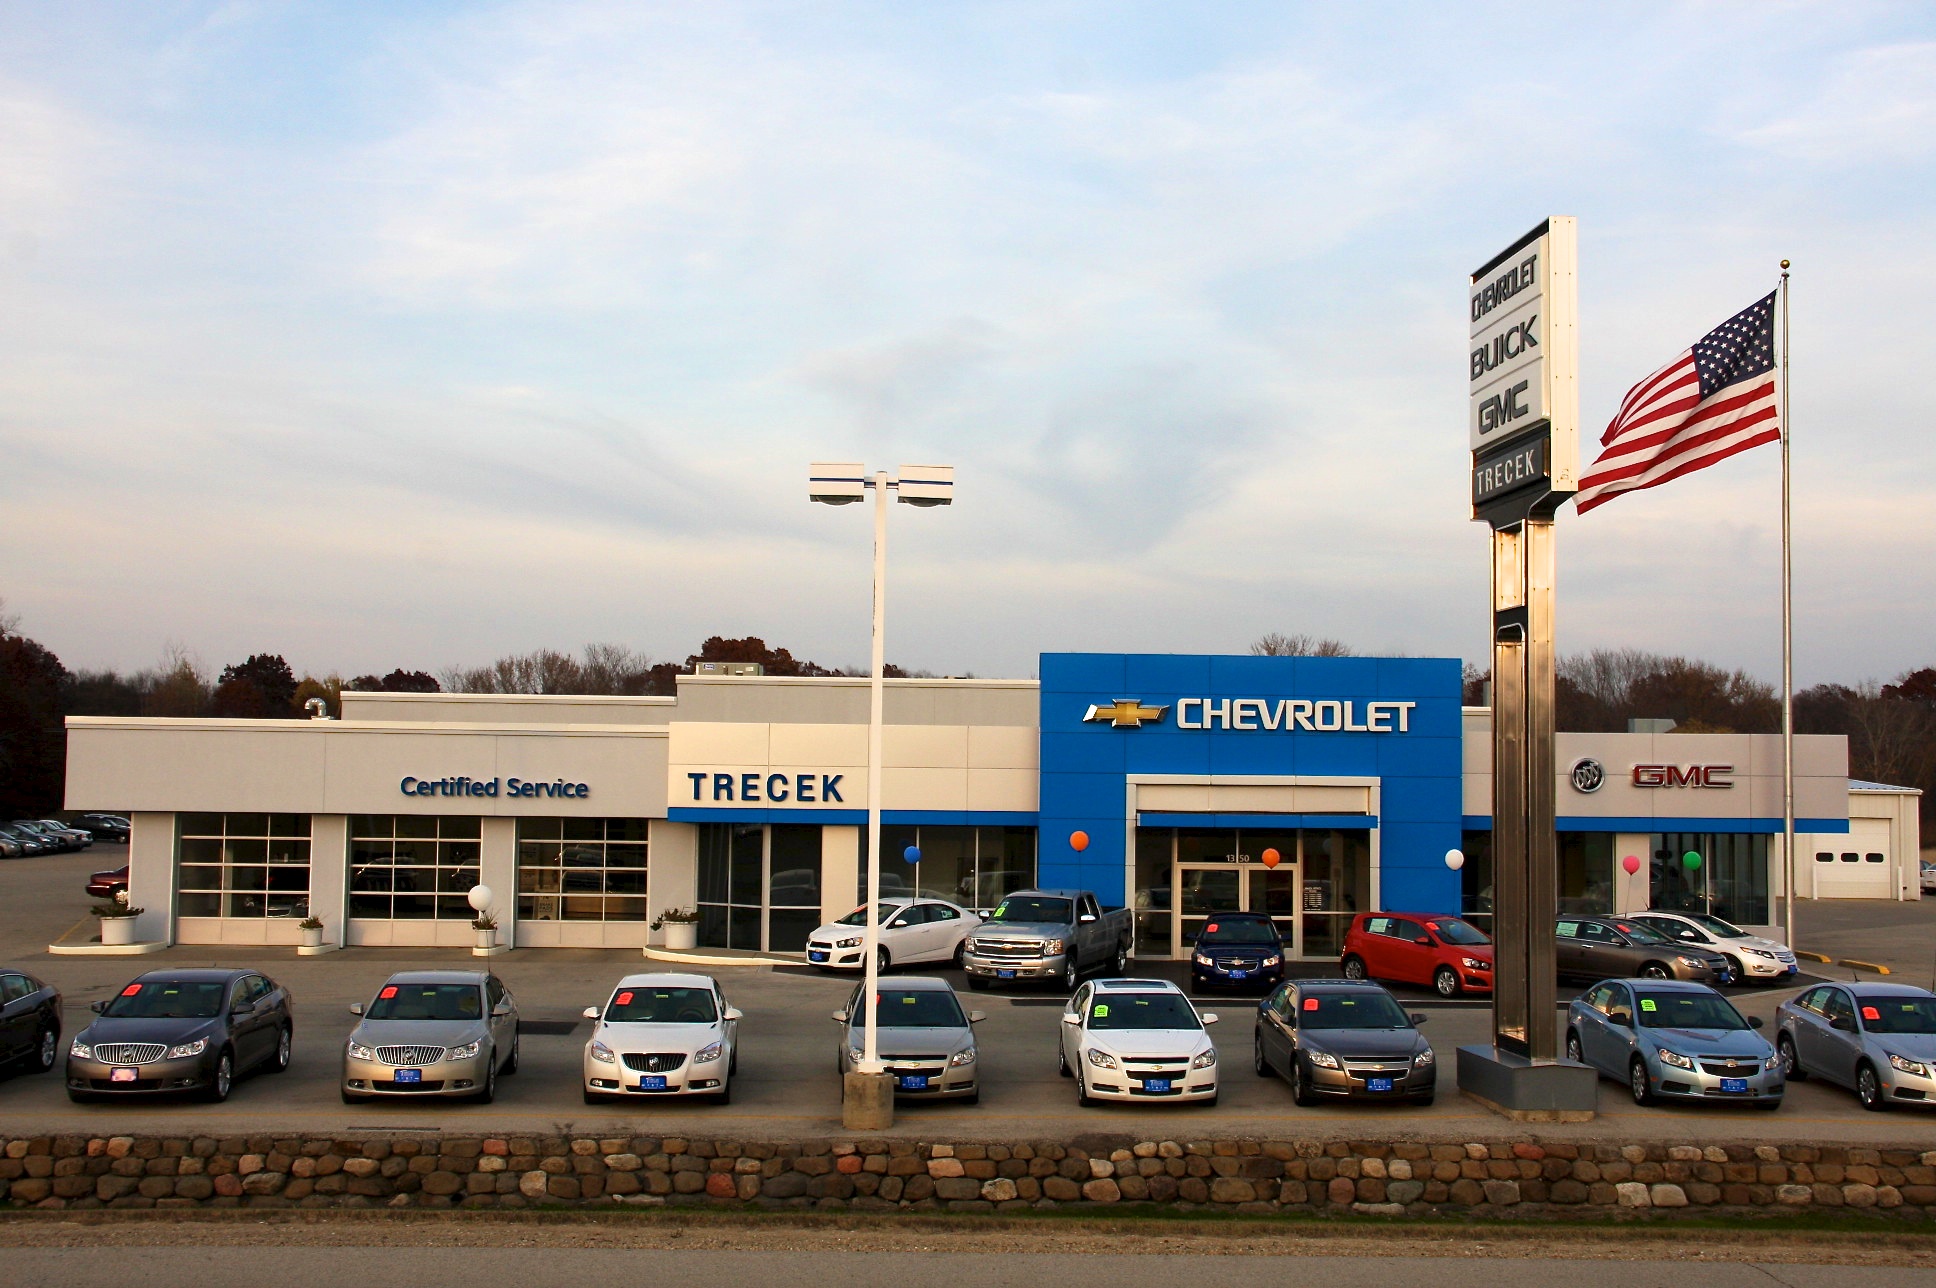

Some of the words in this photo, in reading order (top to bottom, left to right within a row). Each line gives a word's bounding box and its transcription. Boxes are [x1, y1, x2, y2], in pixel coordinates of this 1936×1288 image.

[1471, 254, 1537, 323] CHEVROLET
[1470, 314, 1538, 381] BUICK
[1478, 379, 1529, 435] GMC
[1477, 449, 1535, 496] TRECEK
[1177, 697, 1416, 732] CHEVROLET
[400, 776, 499, 797] Certified
[506, 777, 589, 799] Service
[687, 772, 844, 802] TRECEK
[1632, 764, 1734, 788] GMC
